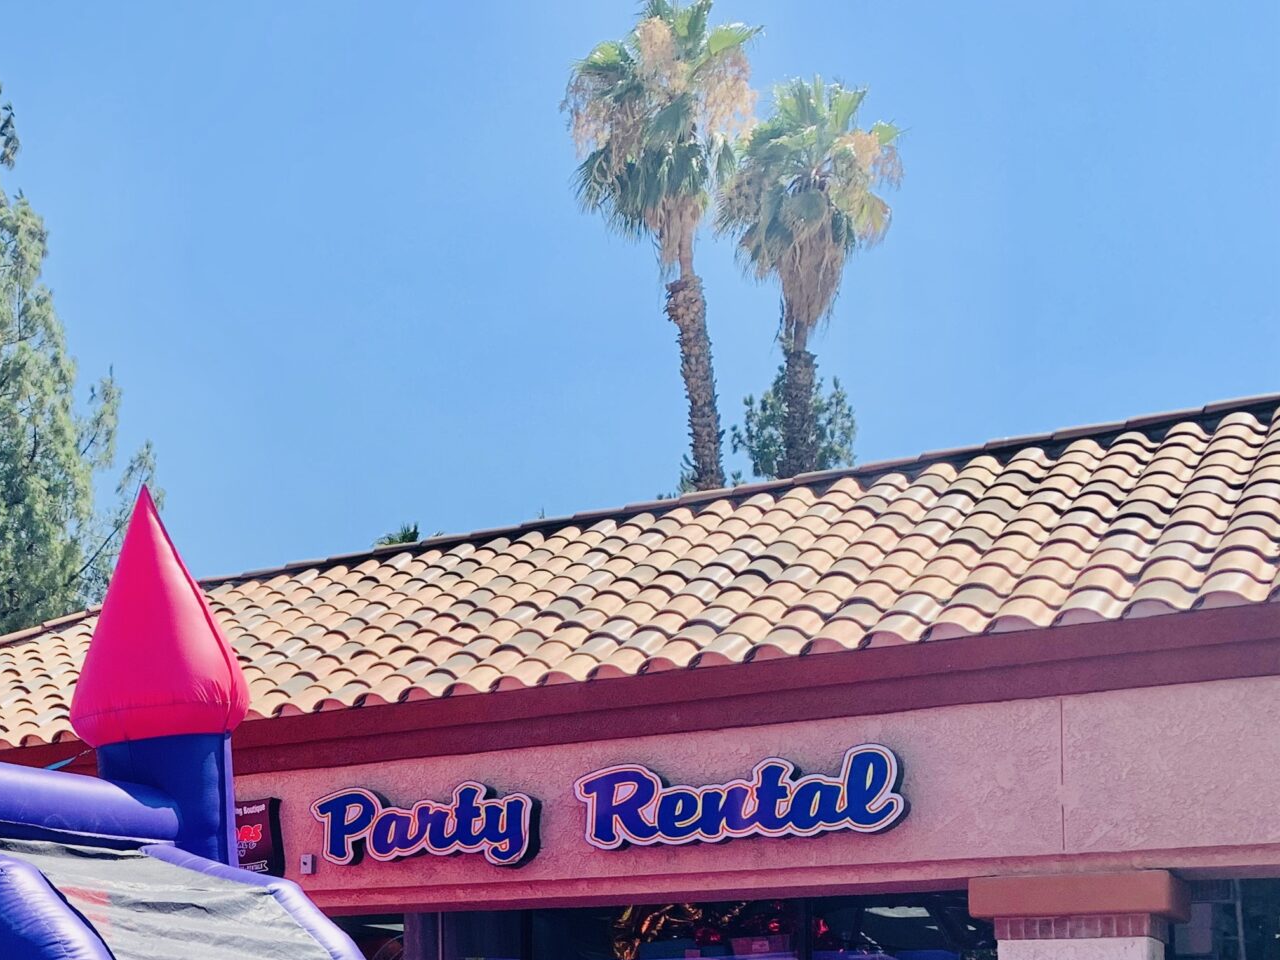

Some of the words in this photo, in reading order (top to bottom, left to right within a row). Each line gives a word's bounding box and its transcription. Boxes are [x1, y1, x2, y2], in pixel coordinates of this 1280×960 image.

[243, 804, 266, 815] Boutique
[309, 780, 532, 866] Party
[573, 743, 905, 850] Rental
[236, 824, 262, 843] RS
